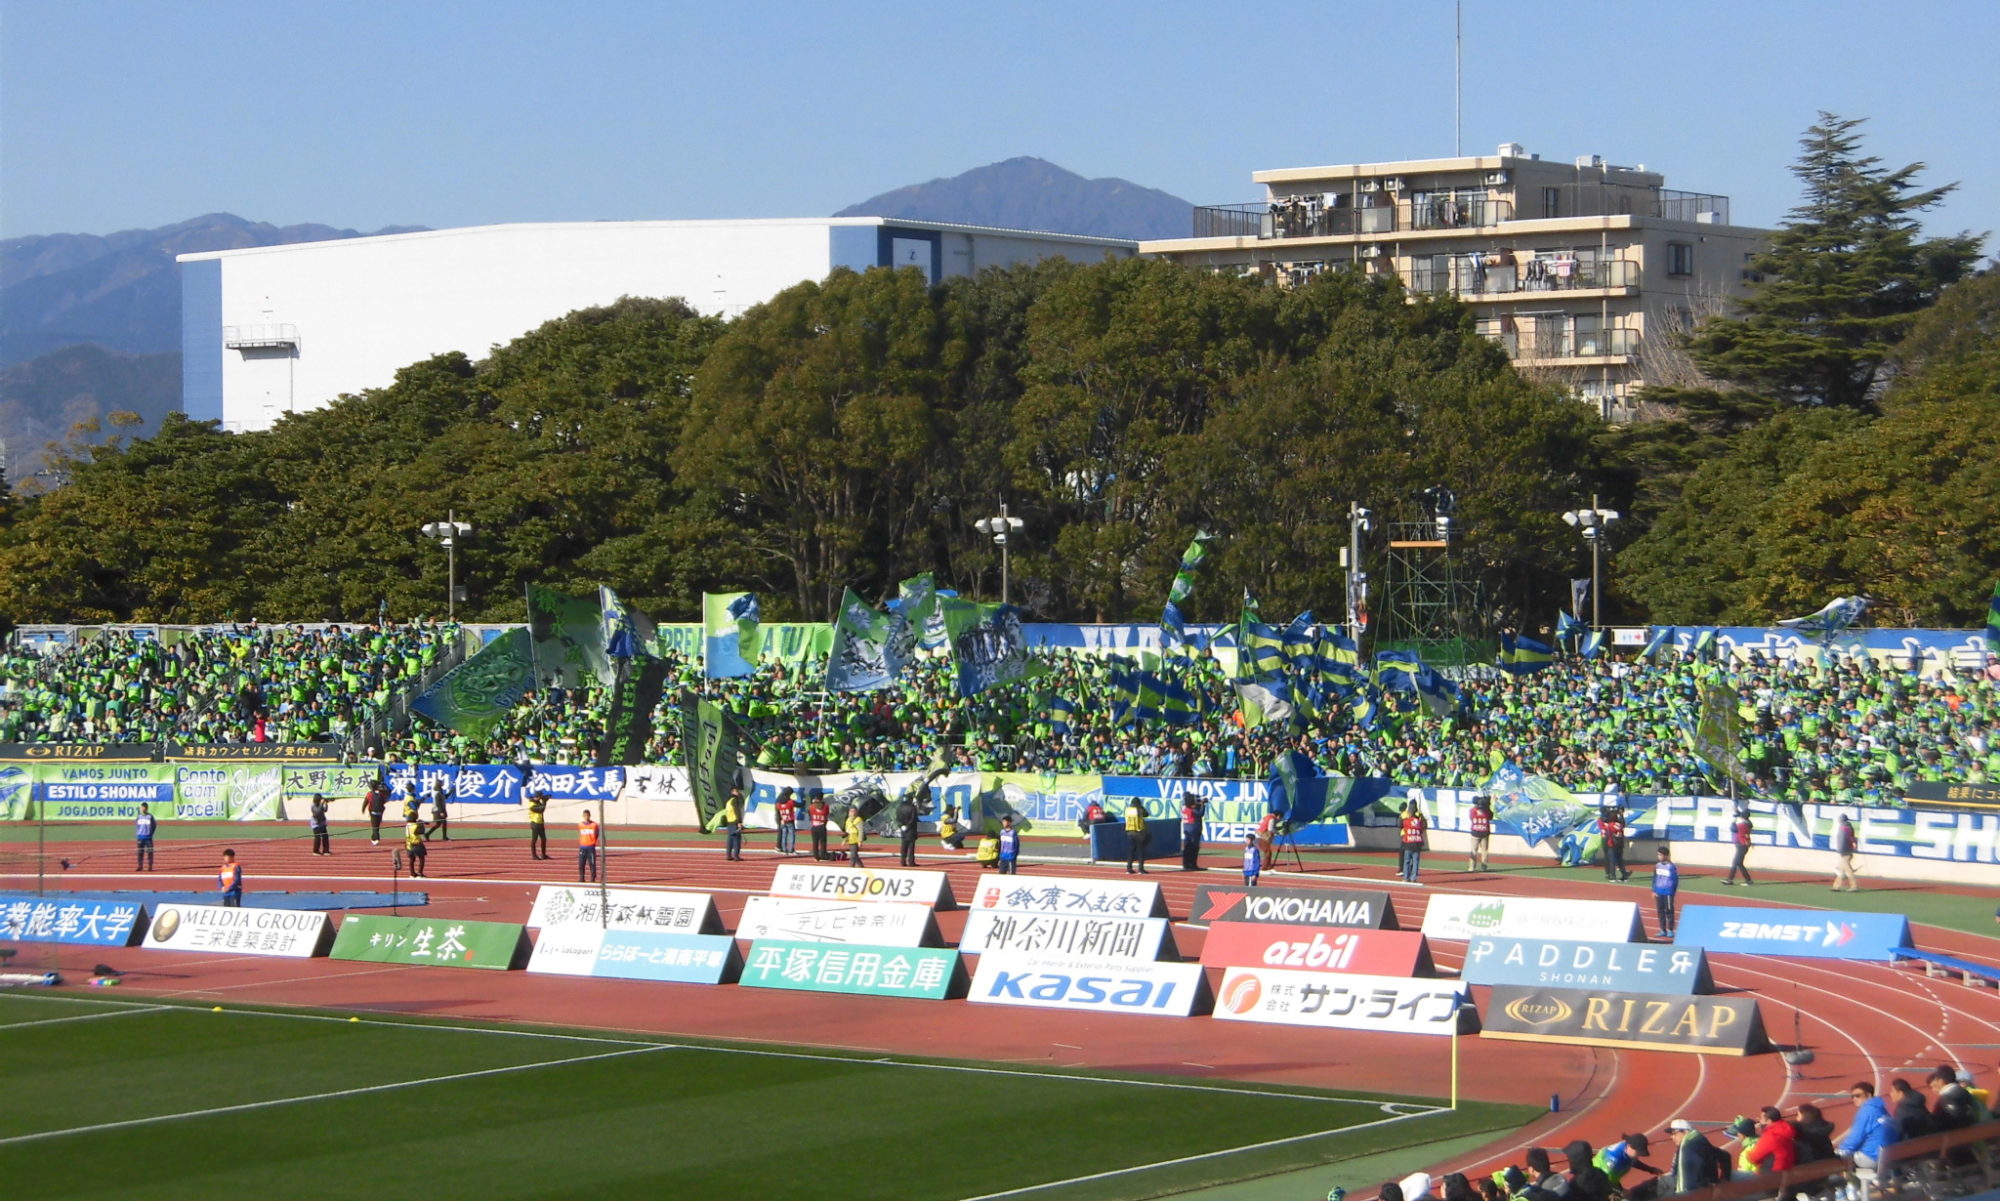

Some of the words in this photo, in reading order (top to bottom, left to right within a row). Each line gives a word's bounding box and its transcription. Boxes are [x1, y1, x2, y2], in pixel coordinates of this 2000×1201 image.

[55, 745, 105, 757] RIZAP
[62, 768, 105, 779] VAMOS
[108, 768, 148, 779] JUNTO
[286, 770, 376, 790] 大野和成
[526, 769, 623, 798] 松田天馬
[49, 786, 98, 798] ESTILO
[100, 786, 158, 799] SHONAN
[1947, 786, 2000, 800] 結果にコ
[57, 806, 114, 818] JOGADOR
[811, 875, 915, 897] VERSION3
[183, 909, 250, 928] MELDIA
[256, 912, 323, 931] GROUP
[1244, 896, 1371, 925] YOKOHAMA
[369, 932, 409, 948] キリン
[410, 925, 468, 961] 生茶
[984, 915, 1145, 958] 神奈川新聞
[1262, 933, 1360, 969] azbil
[753, 945, 949, 992] 平塚信用金庫
[1539, 971, 1613, 985] SHONAN
[1521, 1004, 1557, 1015] RIZAP
[1581, 997, 1736, 1039] RIZAP
